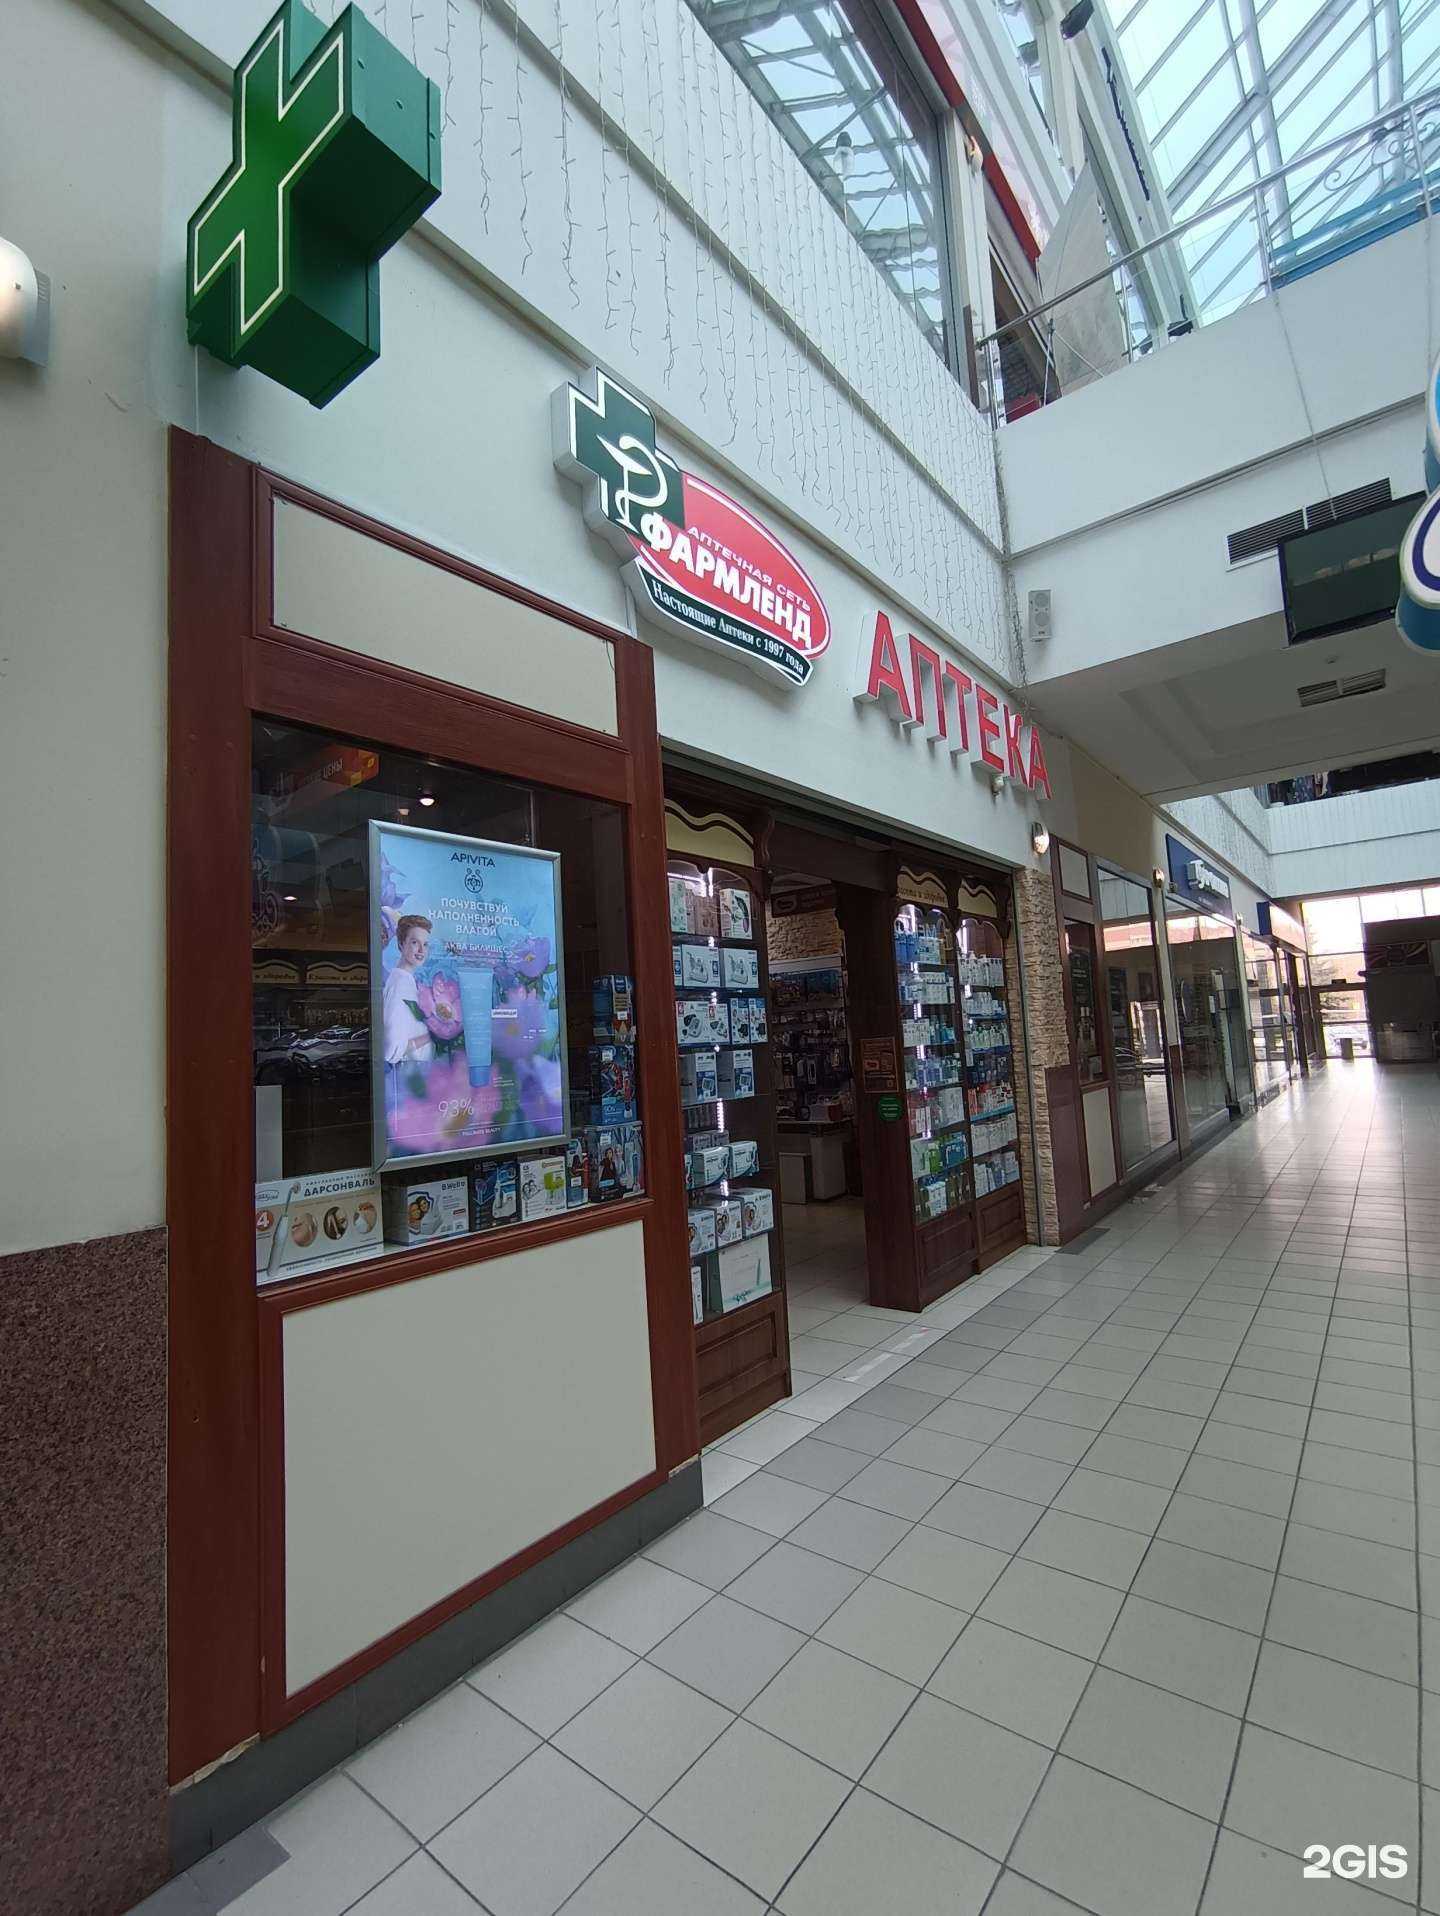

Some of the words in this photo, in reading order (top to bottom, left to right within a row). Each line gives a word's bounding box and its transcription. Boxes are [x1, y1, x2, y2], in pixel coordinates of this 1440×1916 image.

[686, 526, 773, 586] АПТЕЧНАЯ
[776, 583, 811, 612] СЕТЬ
[640, 511, 812, 650] ФАРМЛЕНД
[651, 578, 717, 629] Настоящие
[718, 617, 754, 645] Аптеки
[755, 637, 762, 648] с
[763, 637, 784, 658] 1997
[785, 650, 804, 675] года
[865, 609, 1052, 800] АПТЕКА
[450, 852, 496, 868] APIVITA
[441, 897, 509, 913] ПОЧУВСТВУЙ
[428, 909, 520, 927] НАПОЛНЕННОСТЬ
[455, 924, 497, 937] ВЛАГОЙ
[438, 1097, 474, 1118] 93%
[303, 1178, 376, 1197] ДАРСОНВАЛЬ
[256, 1211, 270, 1228] 4
